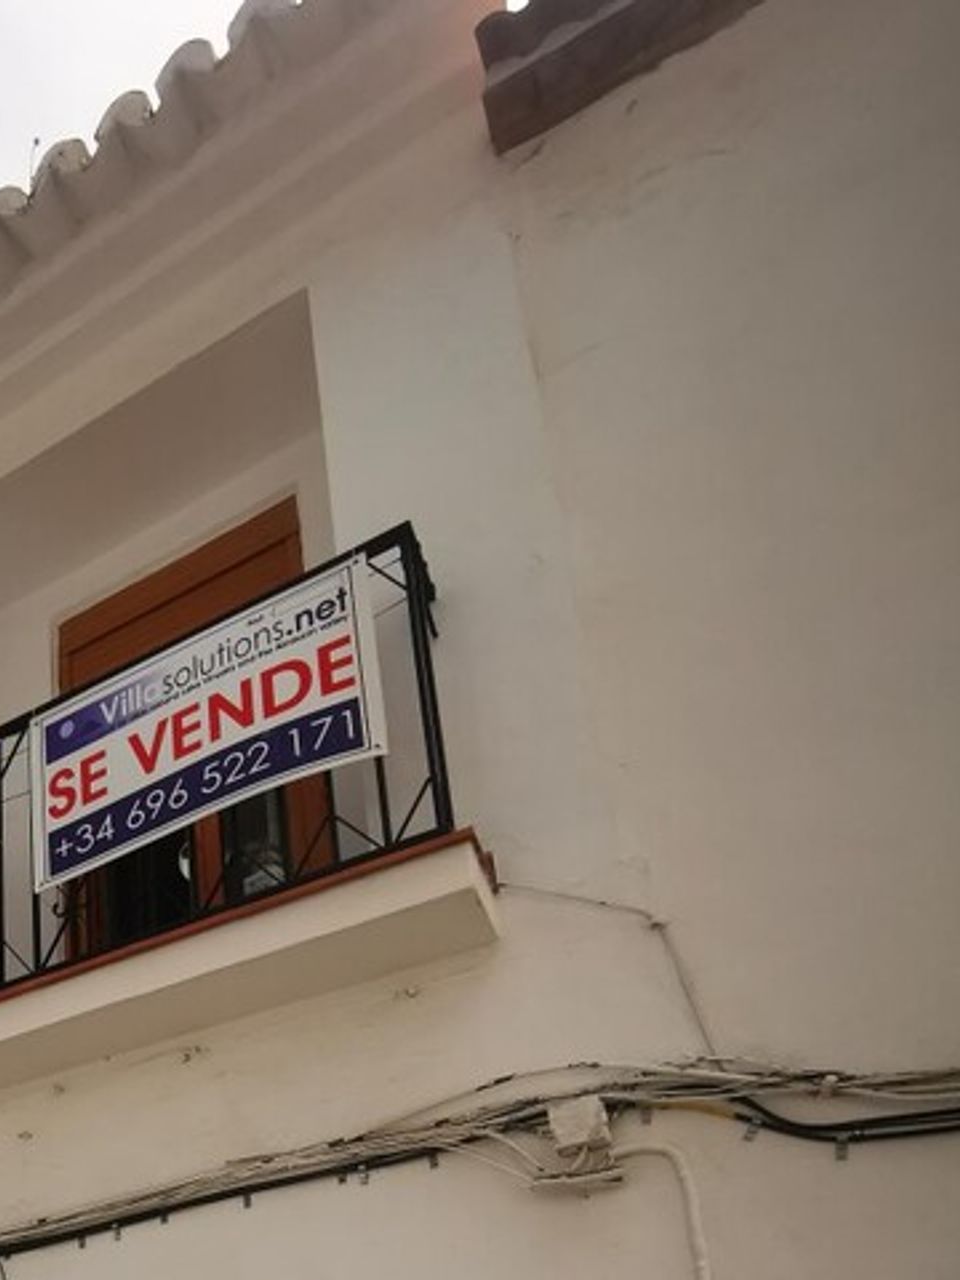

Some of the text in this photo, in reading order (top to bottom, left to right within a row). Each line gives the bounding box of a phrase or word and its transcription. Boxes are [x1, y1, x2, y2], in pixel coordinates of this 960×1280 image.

[48, 750, 109, 822] SE
[127, 634, 357, 777] VENDE
[54, 708, 357, 858] +34 696 522 171
